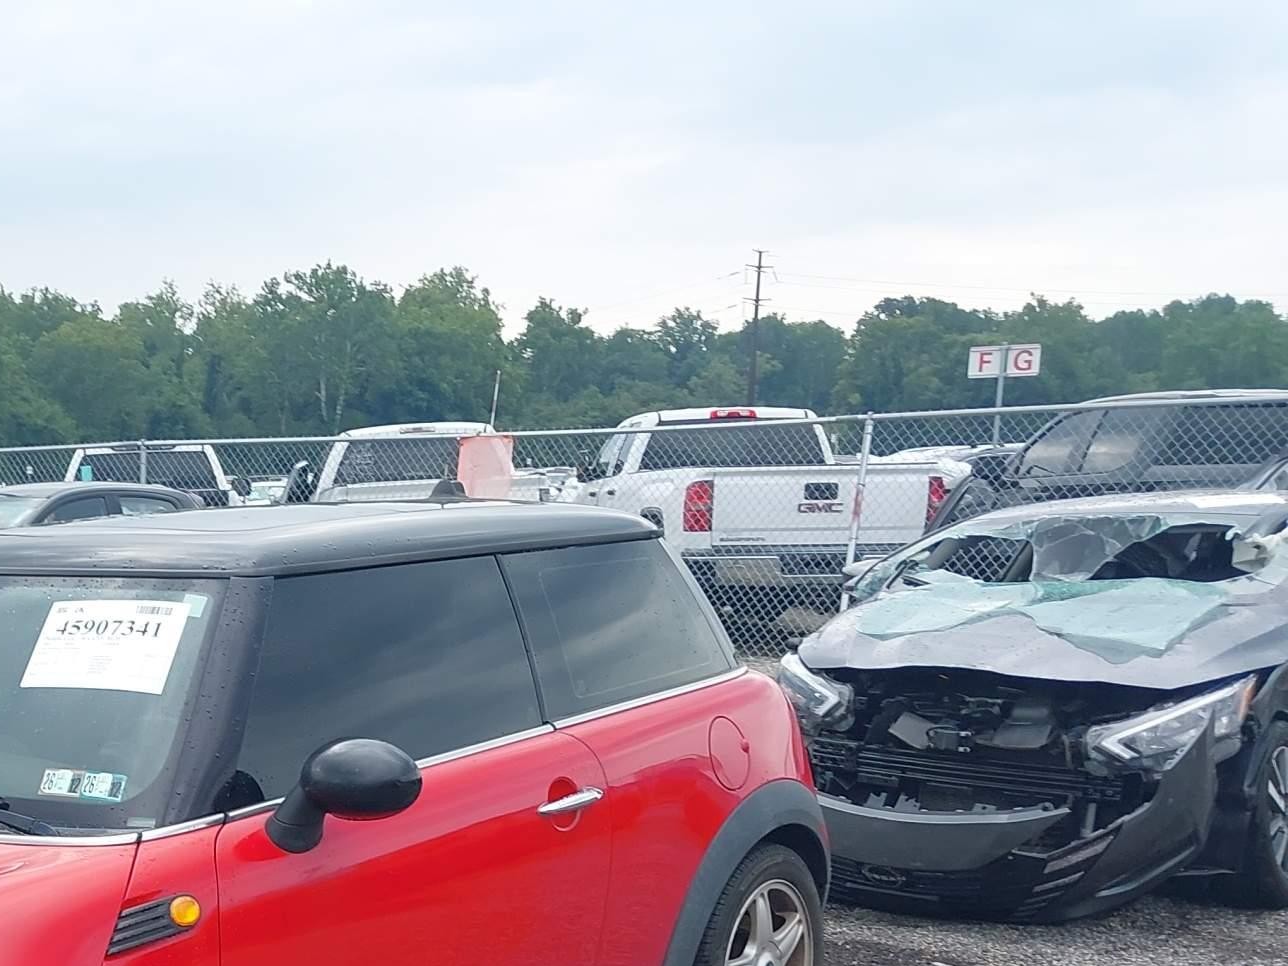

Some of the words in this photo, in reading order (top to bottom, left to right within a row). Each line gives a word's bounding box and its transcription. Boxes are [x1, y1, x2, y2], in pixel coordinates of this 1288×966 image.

[978, 352, 993, 373] F
[1014, 350, 1034, 371] G
[797, 502, 844, 514] GMC
[56, 619, 162, 637] 45907341
[42, 772, 56, 791] 26
[67, 777, 82, 794] 12
[83, 775, 97, 794] 26
[107, 781, 123, 798] 12
